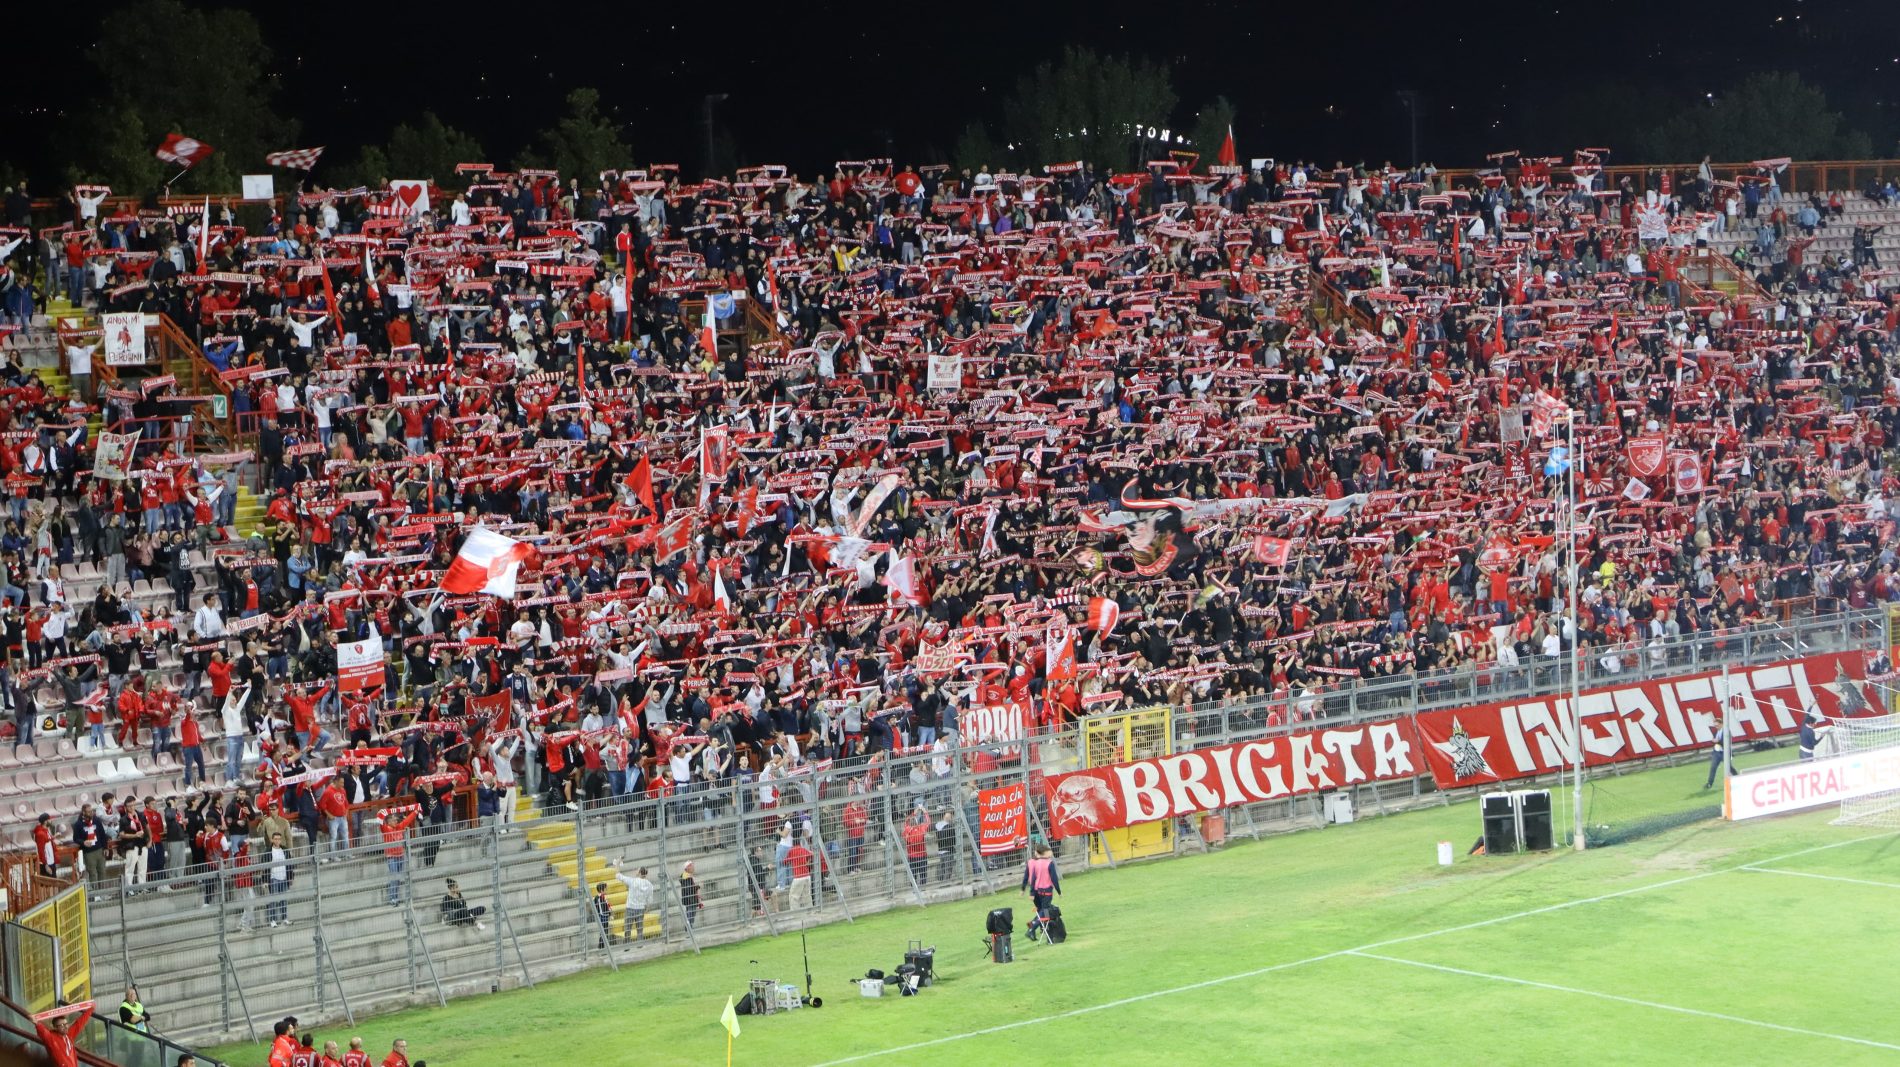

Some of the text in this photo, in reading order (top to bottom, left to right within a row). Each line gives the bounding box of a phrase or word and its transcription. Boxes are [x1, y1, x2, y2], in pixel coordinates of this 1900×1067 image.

[1056, 163, 1077, 171] PERUGIA
[190, 274, 215, 283] PERUGIA
[1, 431, 37, 440] PERUGIA
[830, 430, 865, 440] PERUGIA
[171, 457, 194, 466] PERUGIA
[411, 515, 453, 524] AC PERUGIA
[848, 603, 884, 611] PERUGIA
[116, 623, 139, 632] PERUGIA
[1113, 718, 1415, 825] BRIGATA
[1752, 766, 1850, 808] CENTRAL
